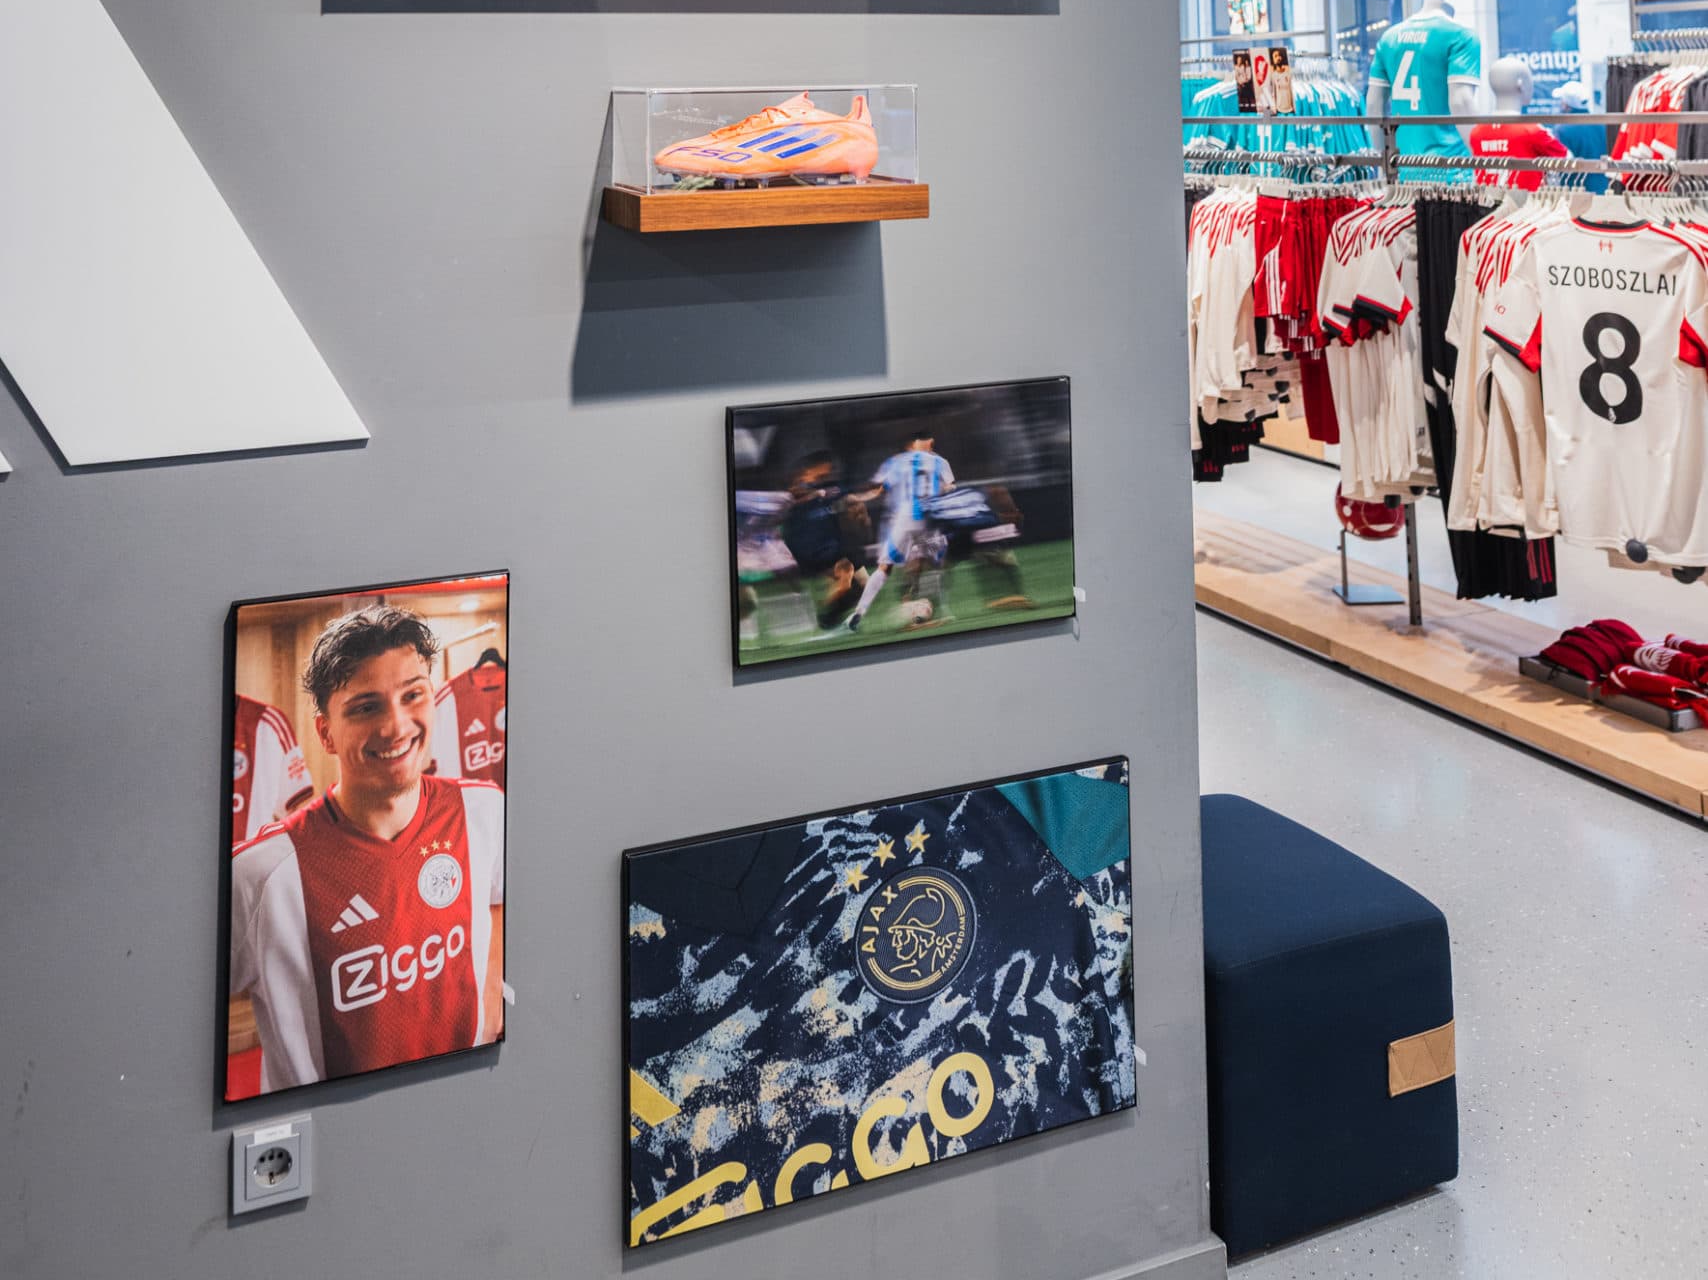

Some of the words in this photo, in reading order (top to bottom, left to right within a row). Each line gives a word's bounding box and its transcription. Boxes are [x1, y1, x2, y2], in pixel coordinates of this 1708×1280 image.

[1391, 50, 1421, 111] 4
[664, 145, 753, 163] F50
[1548, 265, 1677, 296] SZOBOSZLAI
[1579, 312, 1643, 425] 8
[861, 885, 899, 953] AJAX
[940, 915, 966, 974] AMSTERDAM
